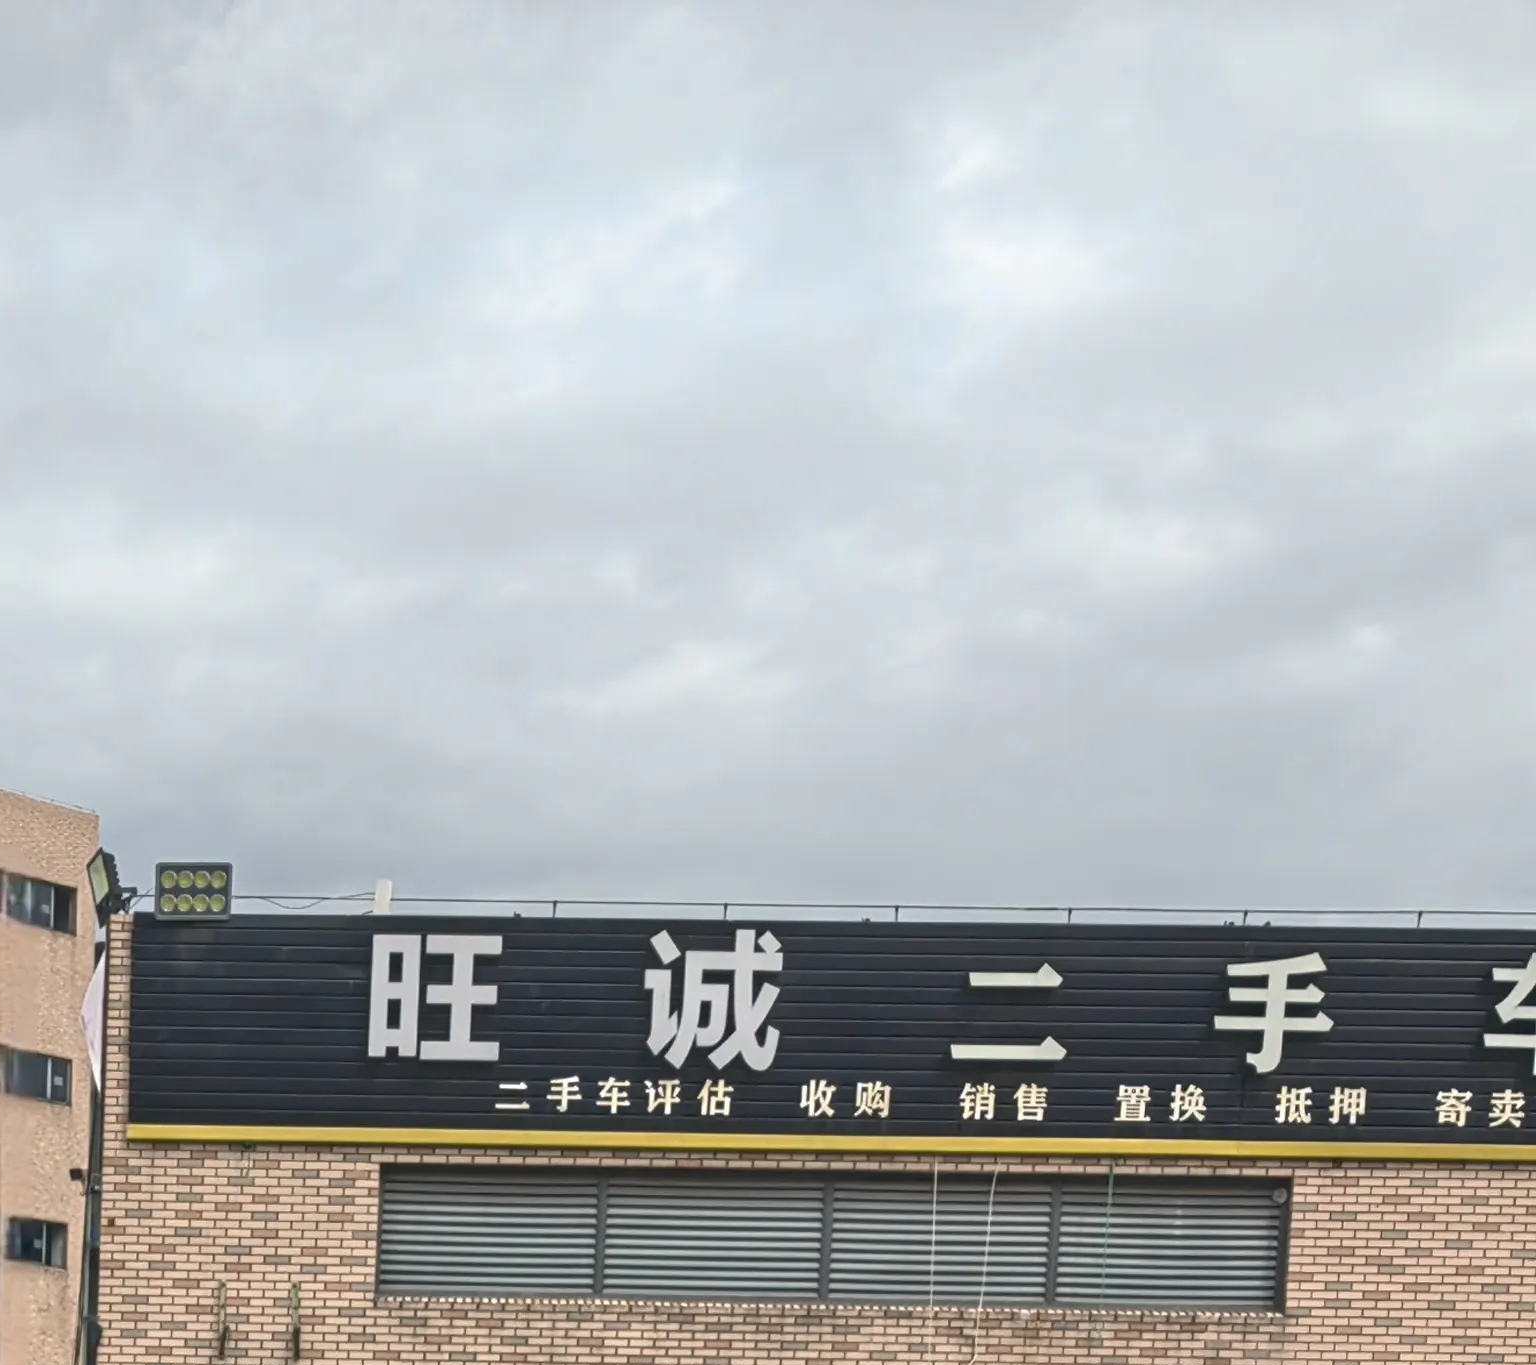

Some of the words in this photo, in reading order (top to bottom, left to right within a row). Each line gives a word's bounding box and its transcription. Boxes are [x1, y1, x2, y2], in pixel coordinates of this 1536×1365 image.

[494, 1076, 735, 1118] 二手车评估
[799, 1079, 892, 1119] 收购
[960, 1082, 1049, 1122] 销售
[1114, 1084, 1208, 1123] 置换
[1274, 1085, 1368, 1125] 抵押
[1435, 1088, 1526, 1128] 寄卖
